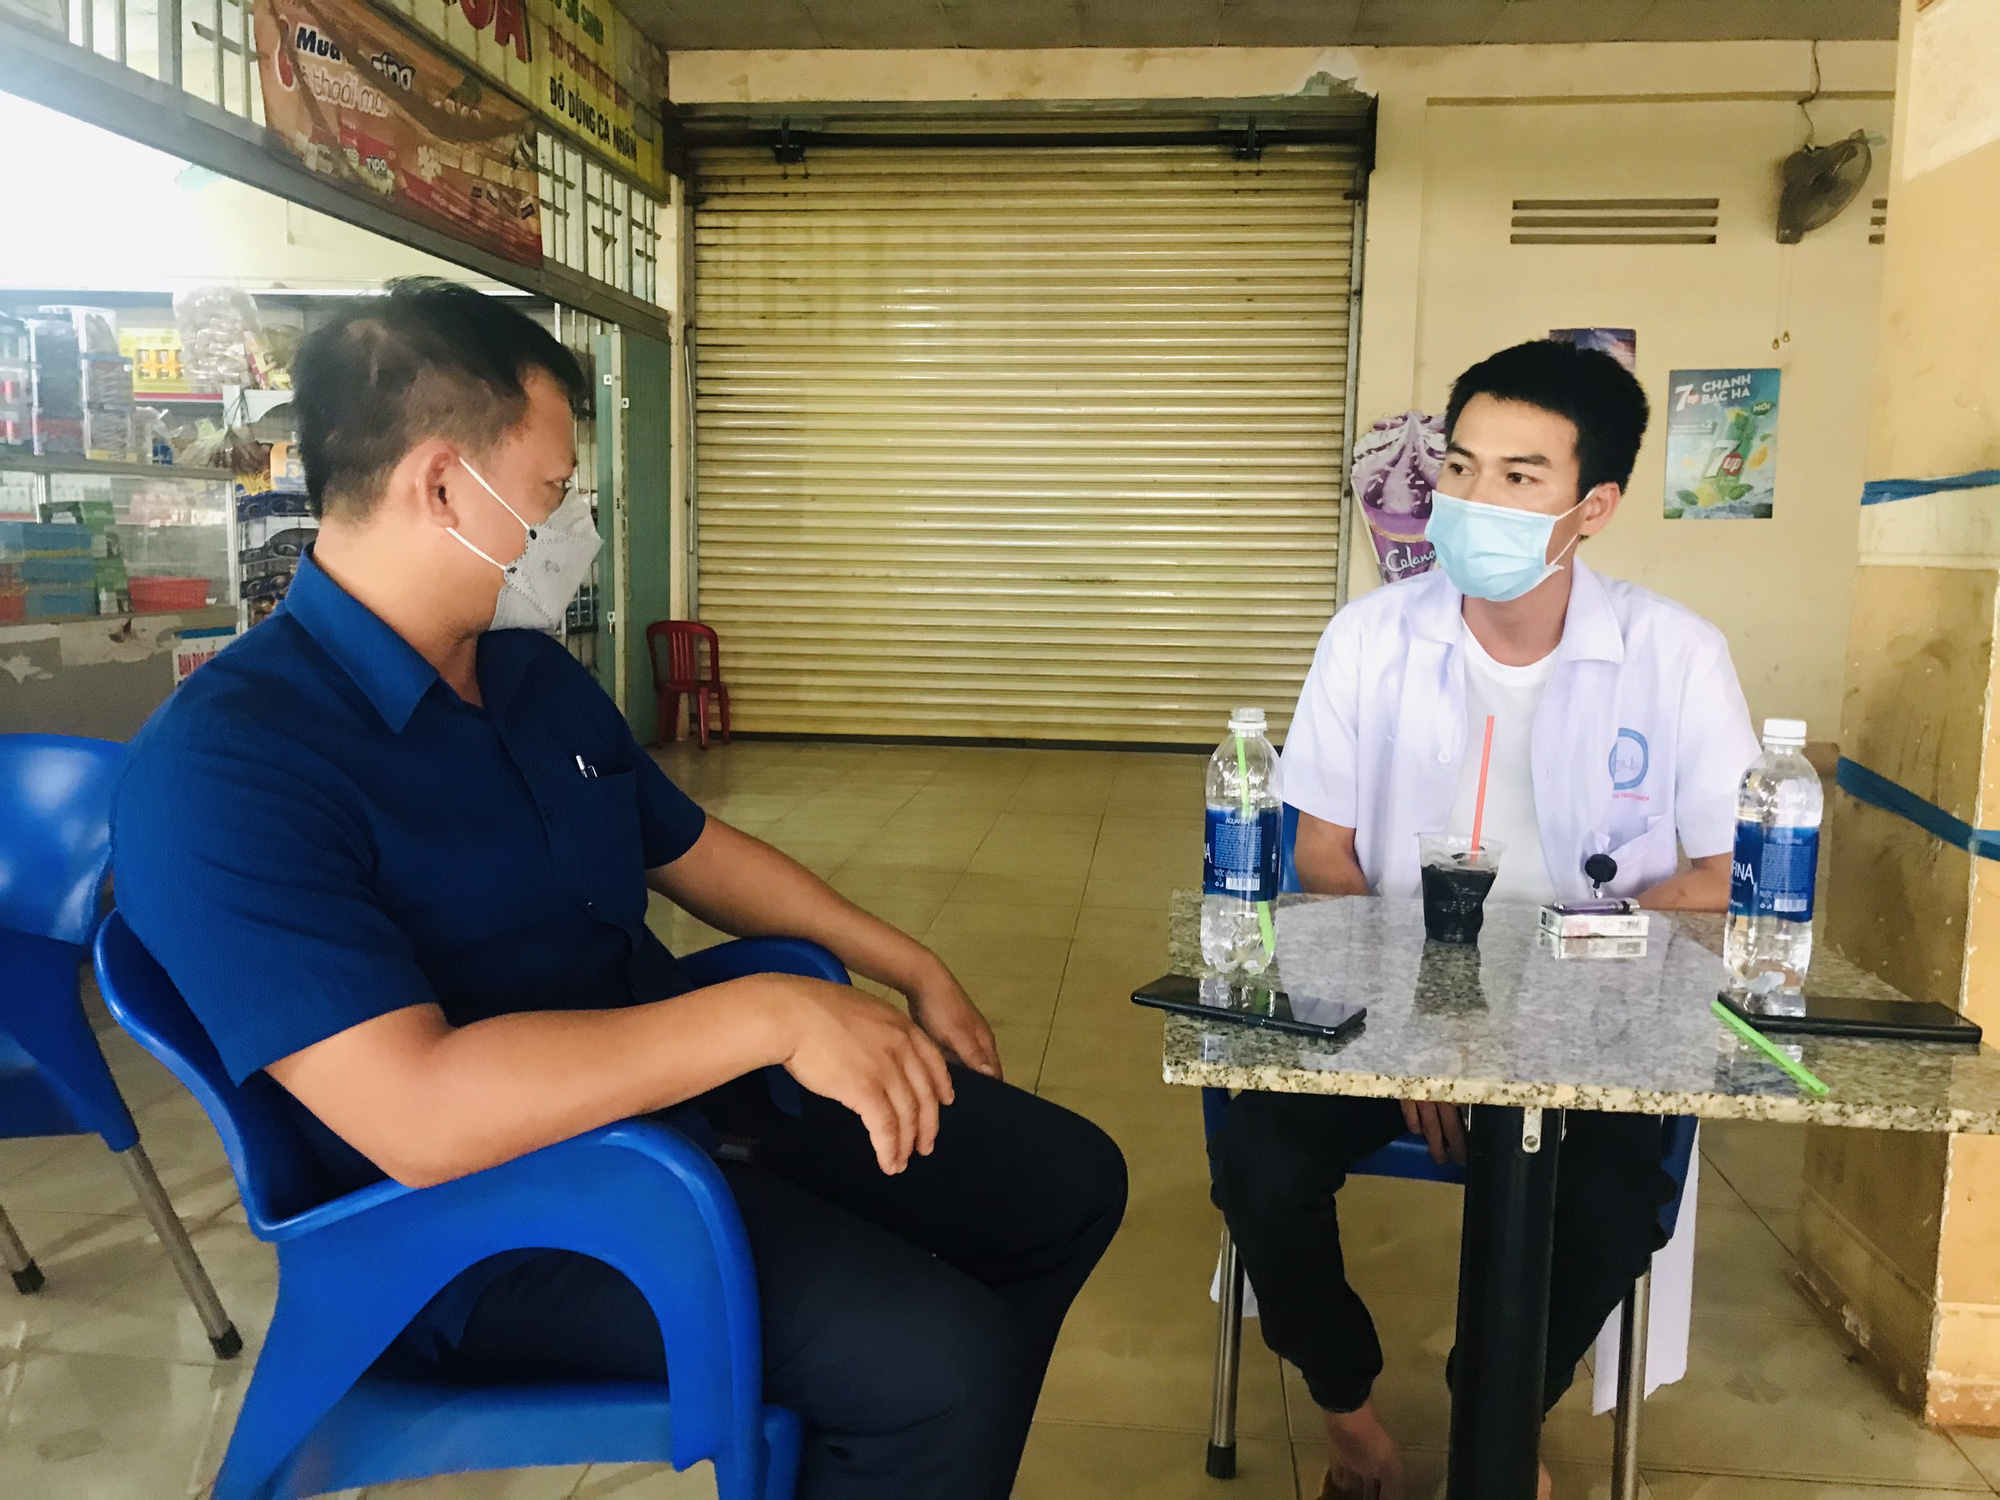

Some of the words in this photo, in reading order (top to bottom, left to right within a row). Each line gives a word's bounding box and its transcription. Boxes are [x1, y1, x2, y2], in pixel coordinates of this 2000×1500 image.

[568, 88, 596, 134] DÙNG
[597, 112, 611, 145] CÁ
[1701, 373, 1751, 392] CHANH
[1385, 545, 1436, 573] Celano
